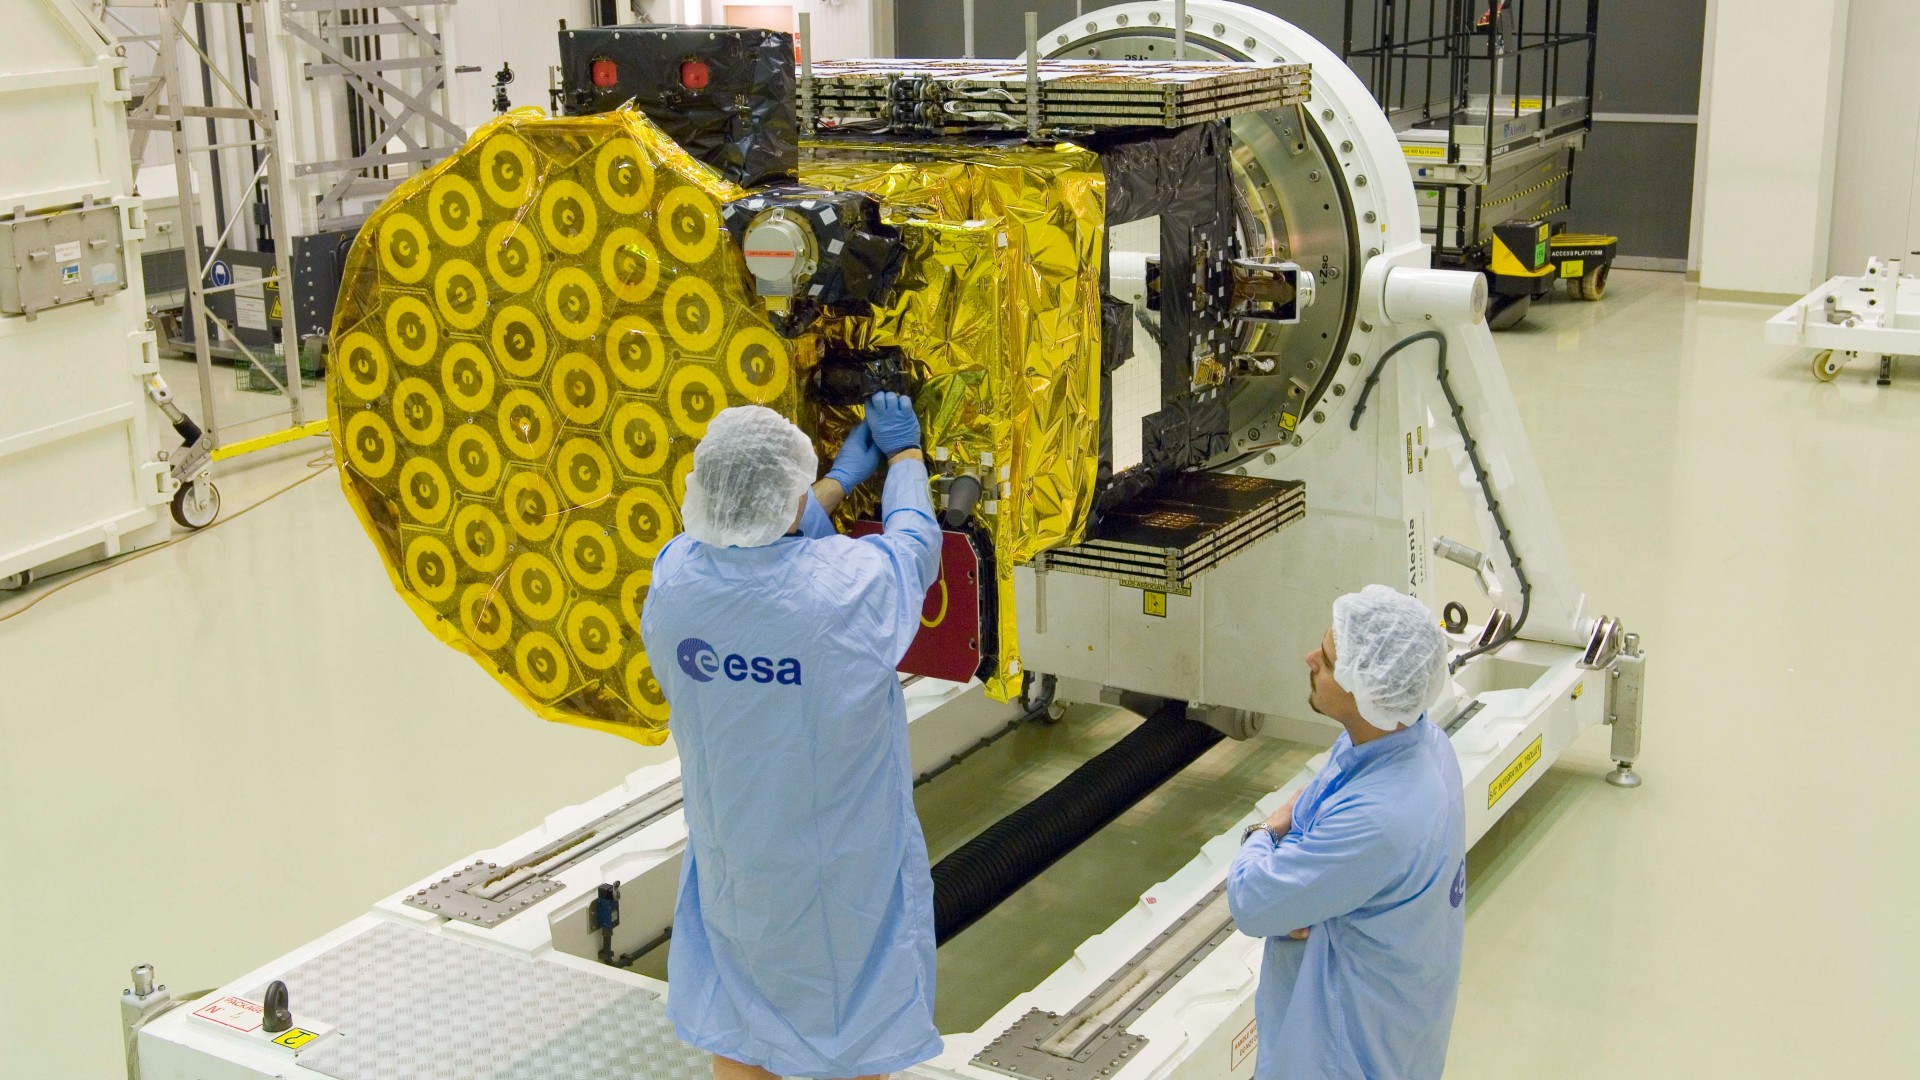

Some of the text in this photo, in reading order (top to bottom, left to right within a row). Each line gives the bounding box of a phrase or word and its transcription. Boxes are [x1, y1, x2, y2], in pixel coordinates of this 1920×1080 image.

[1409, 519, 1417, 587] Alenia
[1137, 581, 1170, 592] ASSOCIATE
[723, 653, 802, 685] esa
[1498, 762, 1523, 791] INTEGRATION
[1524, 744, 1541, 765] TROLLEY
[224, 997, 264, 1014] PACKAGE
